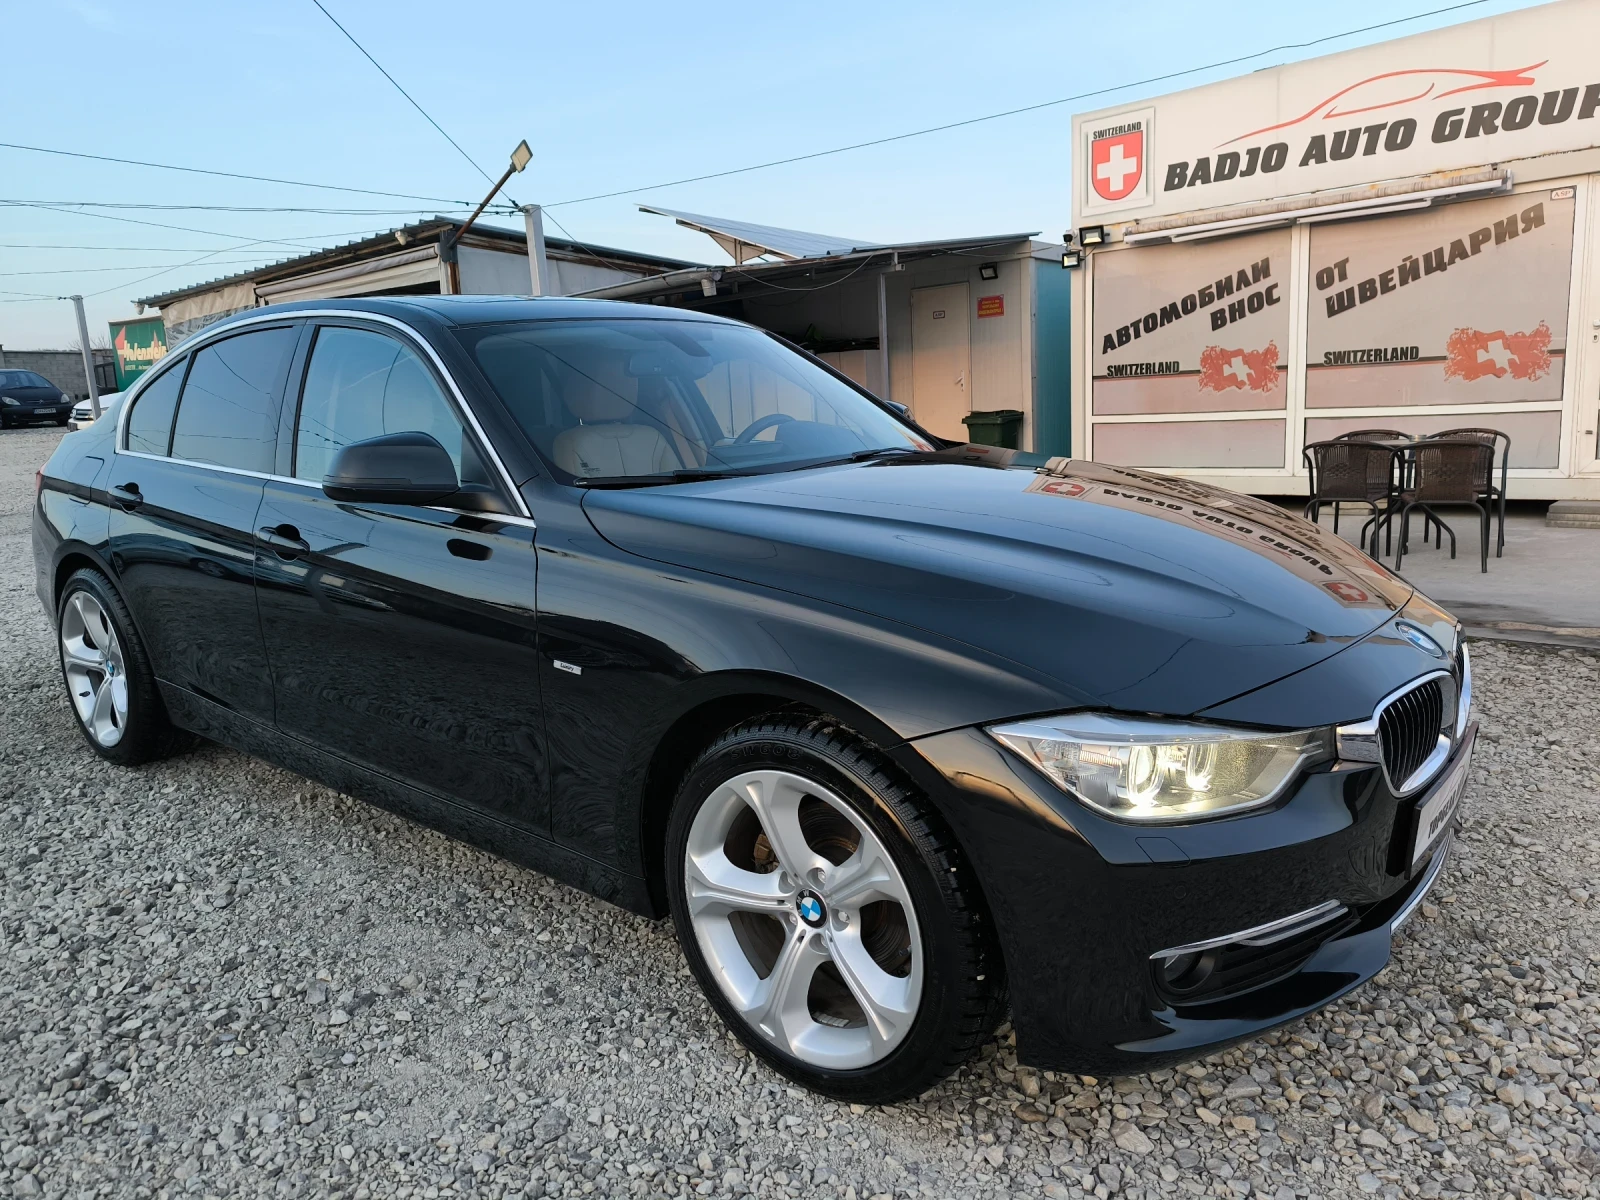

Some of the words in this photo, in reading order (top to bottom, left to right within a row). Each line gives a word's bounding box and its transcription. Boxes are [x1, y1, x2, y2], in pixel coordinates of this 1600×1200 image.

[1092, 121, 1142, 140] SWITZERLAND
[1163, 142, 1289, 192] BADJO
[1298, 117, 1418, 168] AUTO
[1315, 257, 1350, 291] ОТ
[1325, 202, 1546, 318] ШВЕЙЦАРИЯ
[1102, 257, 1272, 355] АВТОМОБИЛИ
[1210, 282, 1281, 332] ВНОС
[1107, 361, 1180, 377] SWITZERLAND
[1323, 346, 1420, 366] SWITZERLAND
